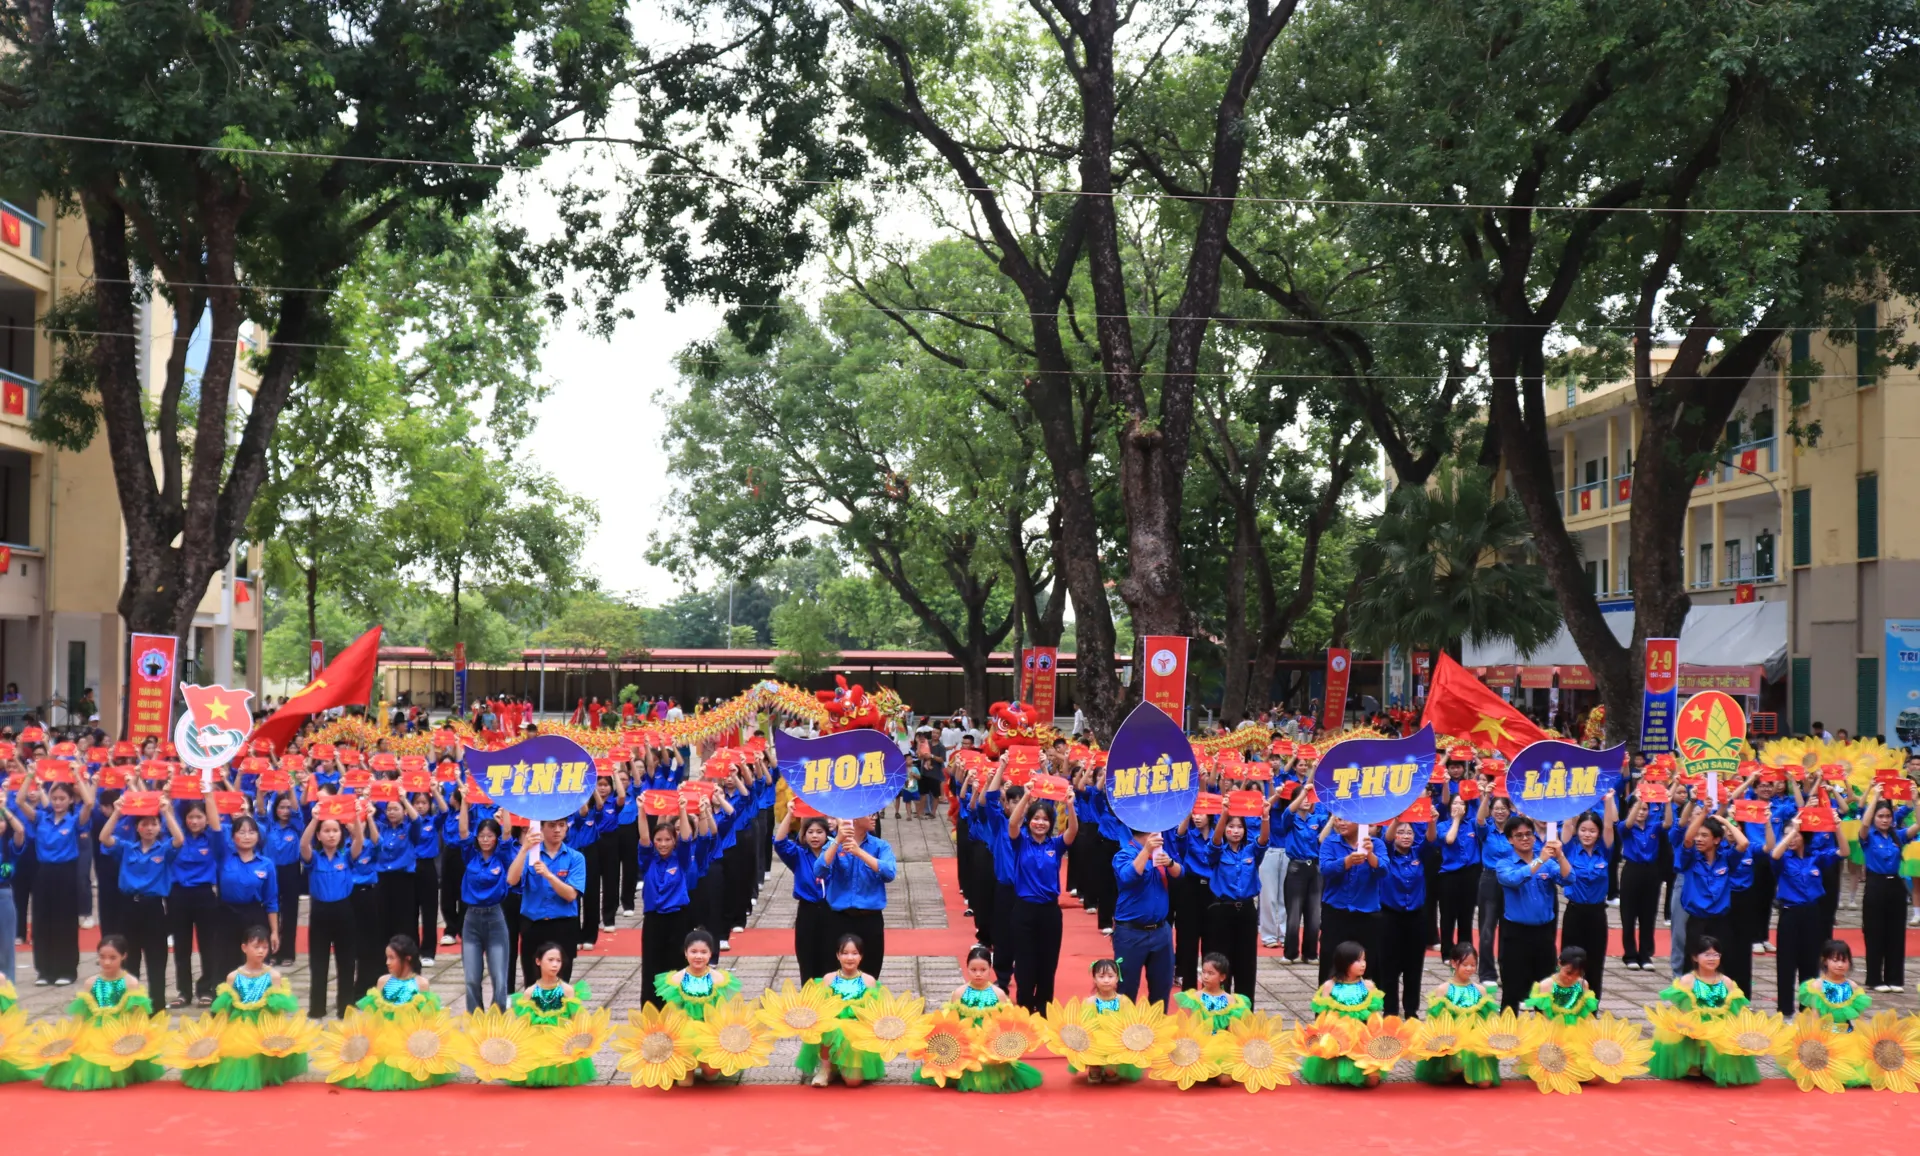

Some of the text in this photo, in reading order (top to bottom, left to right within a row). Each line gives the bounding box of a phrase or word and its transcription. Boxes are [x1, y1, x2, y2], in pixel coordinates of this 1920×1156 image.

[1650, 650, 1672, 670] 2-9
[802, 751, 886, 794] HOA
[1522, 761, 1600, 800] LÂM
